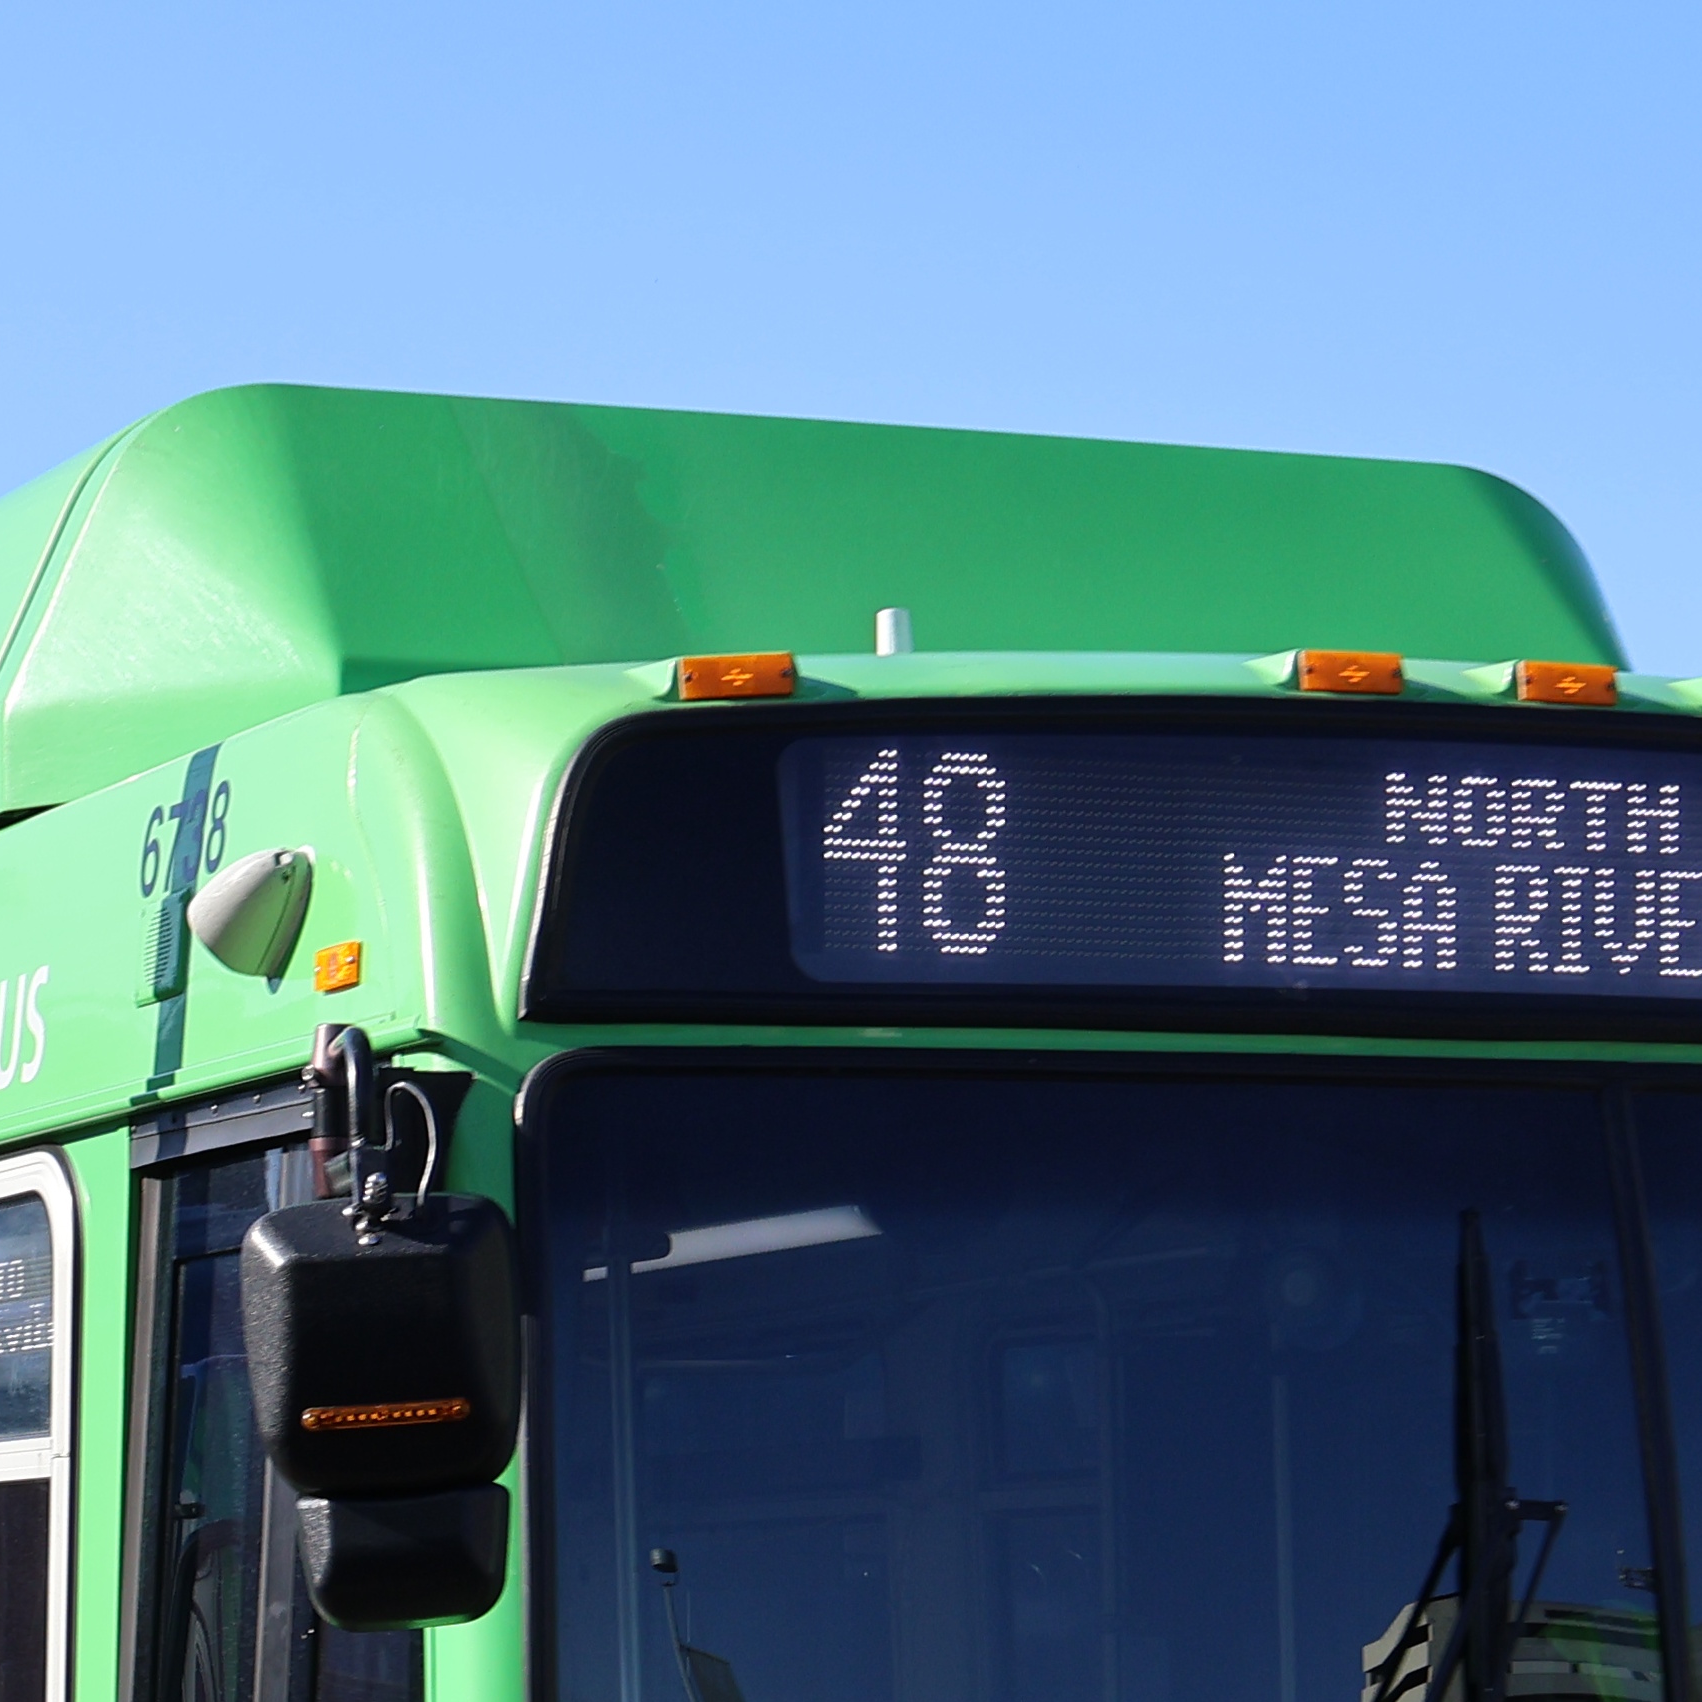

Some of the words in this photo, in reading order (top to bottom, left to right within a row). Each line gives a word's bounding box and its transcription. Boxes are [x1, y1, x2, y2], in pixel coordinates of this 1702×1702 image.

[140, 780, 231, 898] 6738
[822, 748, 1007, 953] 48
[1384, 772, 1680, 854] NORTH
[1224, 853, 1456, 969] MESA
